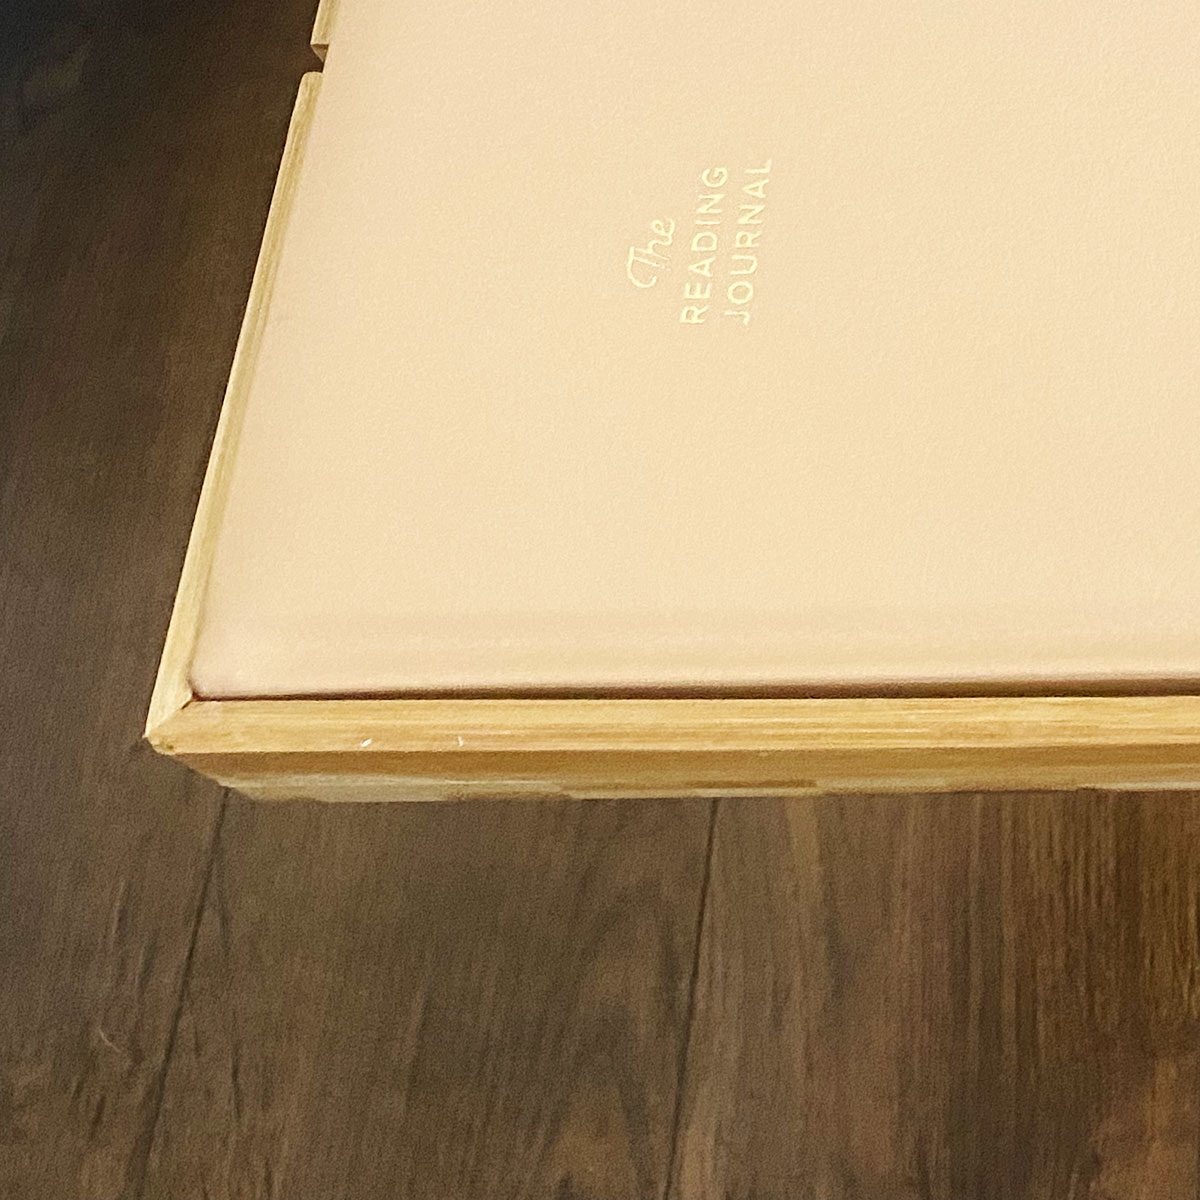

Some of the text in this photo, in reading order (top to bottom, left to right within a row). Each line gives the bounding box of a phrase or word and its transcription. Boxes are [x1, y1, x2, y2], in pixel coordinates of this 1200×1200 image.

[627, 218, 675, 288] The
[679, 167, 728, 324] READING
[724, 159, 772, 326] JOURNAL
